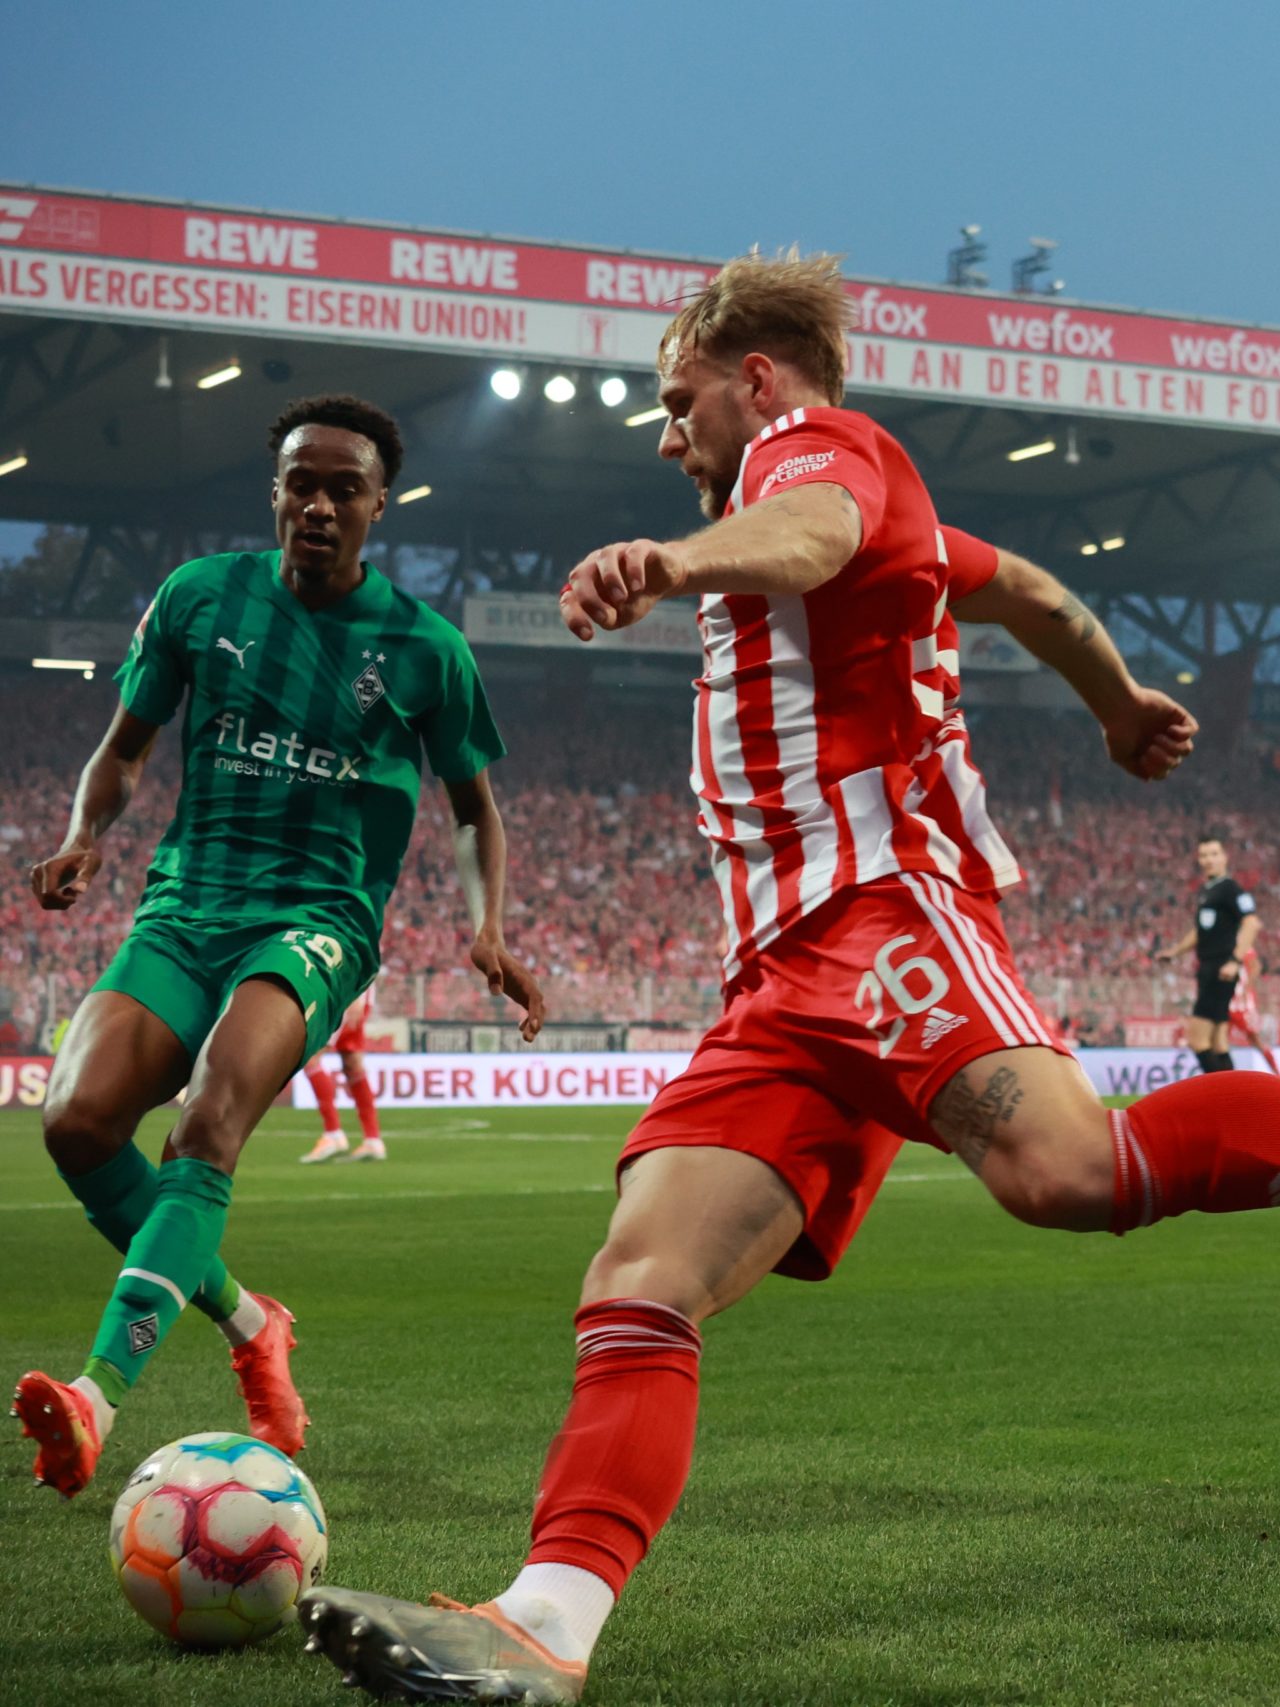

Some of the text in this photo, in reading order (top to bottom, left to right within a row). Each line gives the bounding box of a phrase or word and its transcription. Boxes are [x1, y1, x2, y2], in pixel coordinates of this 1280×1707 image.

[185, 217, 318, 270] REWE
[390, 238, 518, 290] REWE
[60, 263, 268, 319] VERGESSEN:
[287, 286, 400, 331] EISERN
[413, 298, 526, 344] UNION!
[988, 310, 1114, 358] wefox
[911, 348, 962, 391] AN
[987, 357, 1059, 400] DER
[1085, 367, 1204, 415] ALTEN
[776, 450, 835, 473] COMEDY
[214, 753, 260, 777] invest
[493, 1060, 668, 1098] KÜCHEN
